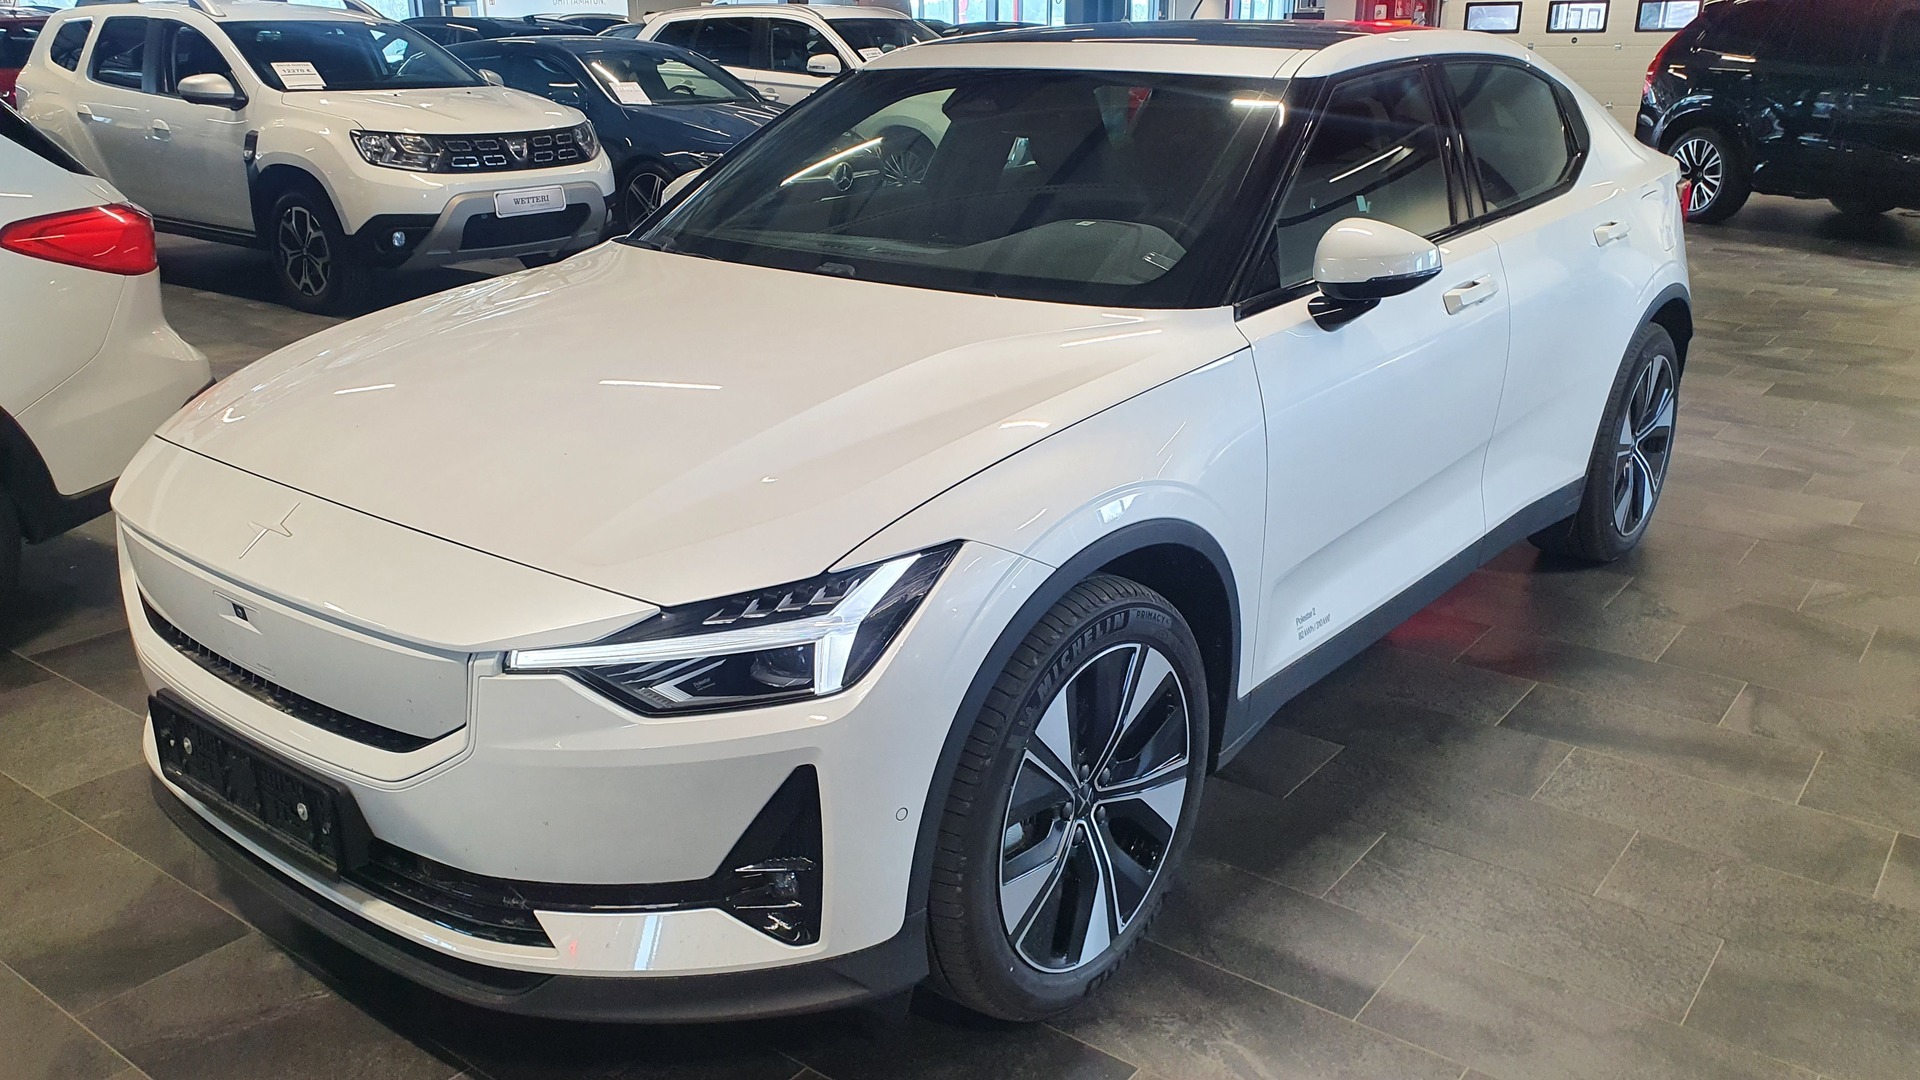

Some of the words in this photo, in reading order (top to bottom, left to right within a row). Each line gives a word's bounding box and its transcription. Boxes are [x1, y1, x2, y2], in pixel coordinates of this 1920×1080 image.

[513, 195, 550, 205] WETTERI
[1136, 610, 1166, 624] PRIMACY
[1295, 611, 1313, 627] Polestar
[1037, 612, 1126, 703] MICHELIN
